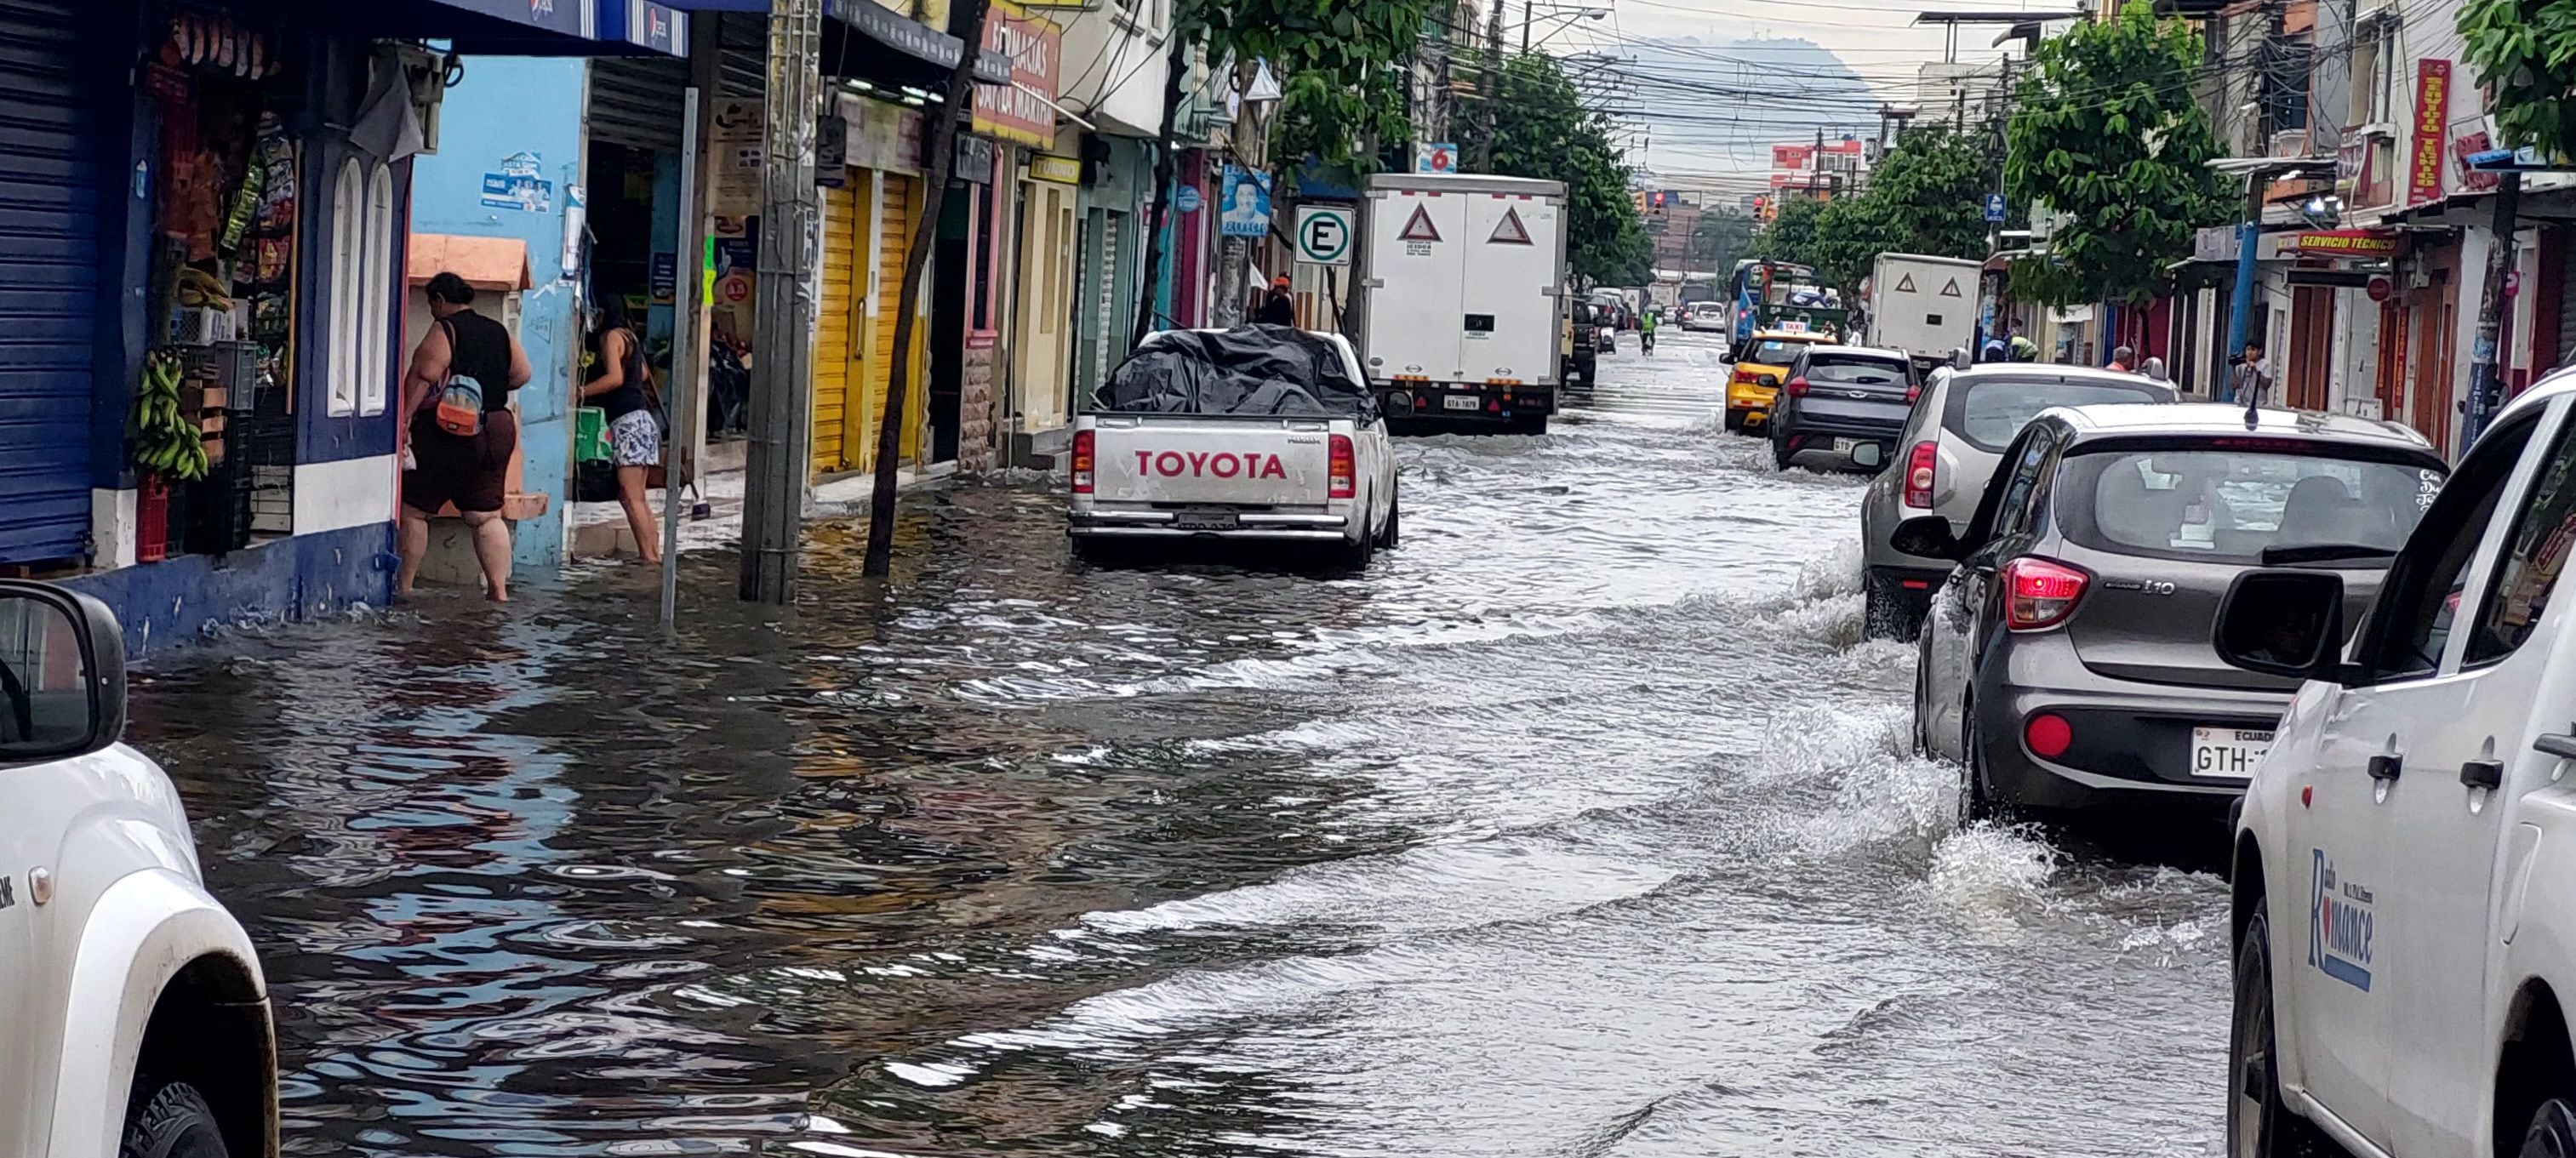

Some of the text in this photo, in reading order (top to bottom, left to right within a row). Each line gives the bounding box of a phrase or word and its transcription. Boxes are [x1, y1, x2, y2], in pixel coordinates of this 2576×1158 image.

[992, 21, 1048, 78] FARMACIAS
[1431, 148, 1449, 171] 6
[1311, 221, 1336, 252] E
[2300, 235, 2350, 248] SERVICIO
[2351, 236, 2397, 250] TÉCNICO
[1134, 450, 1288, 480] TOYOTA
[2197, 745, 2267, 773] GTH-
